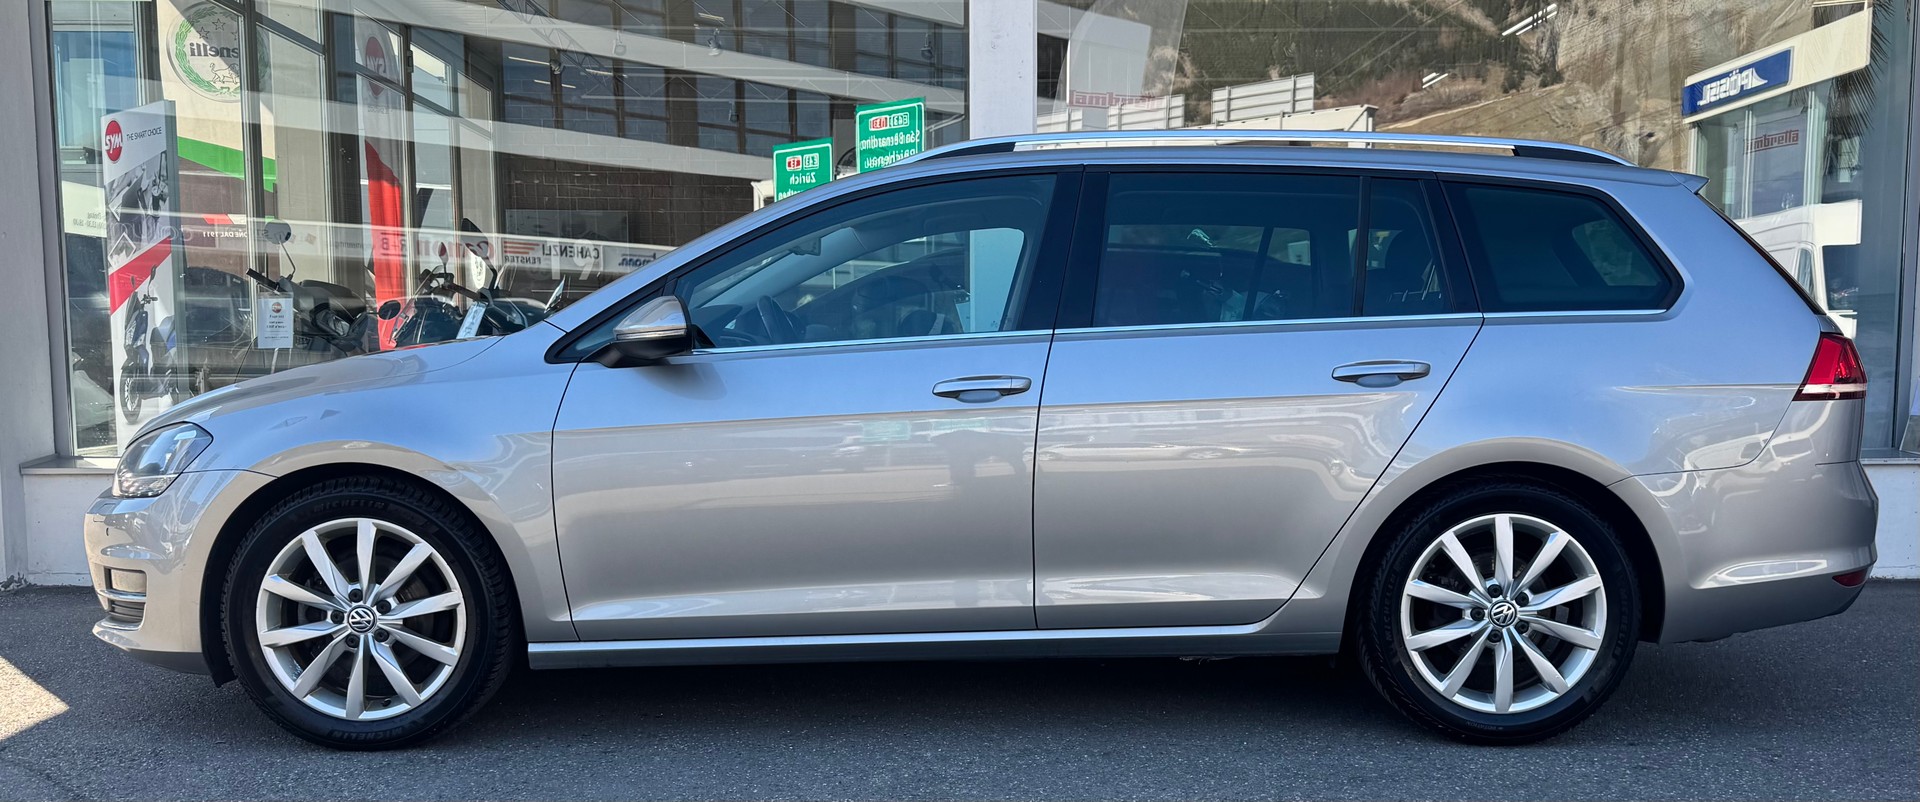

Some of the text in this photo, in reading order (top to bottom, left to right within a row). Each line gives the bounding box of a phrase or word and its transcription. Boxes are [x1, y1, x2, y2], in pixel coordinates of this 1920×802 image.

[105, 133, 122, 154] SYM
[1743, 130, 1799, 155] ambretta
[314, 499, 385, 513] MICHELIN
